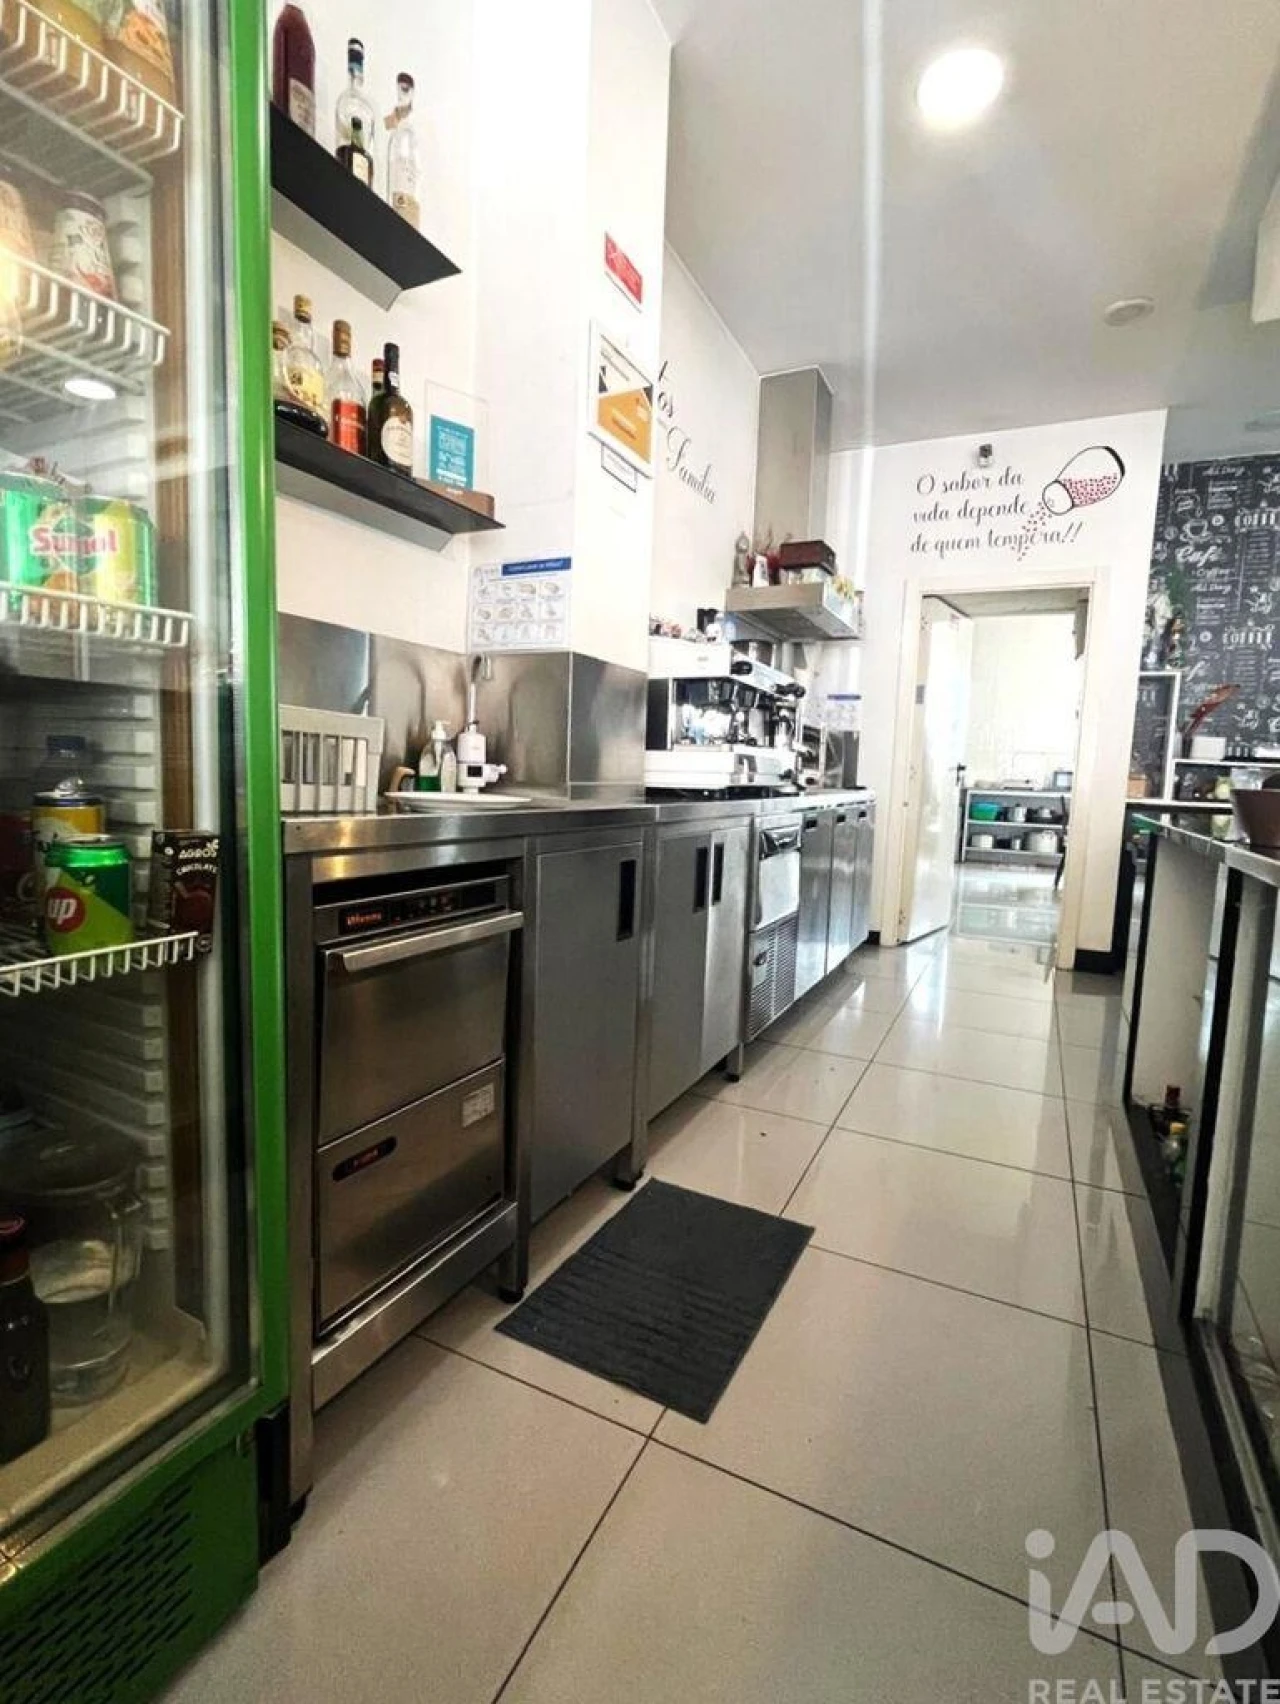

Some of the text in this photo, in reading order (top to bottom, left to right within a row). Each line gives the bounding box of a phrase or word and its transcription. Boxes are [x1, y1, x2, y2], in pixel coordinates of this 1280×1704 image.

[916, 466, 1024, 495] O sabor da
[913, 494, 1026, 526] vida depende
[910, 522, 1083, 560] de quem tempera!!
